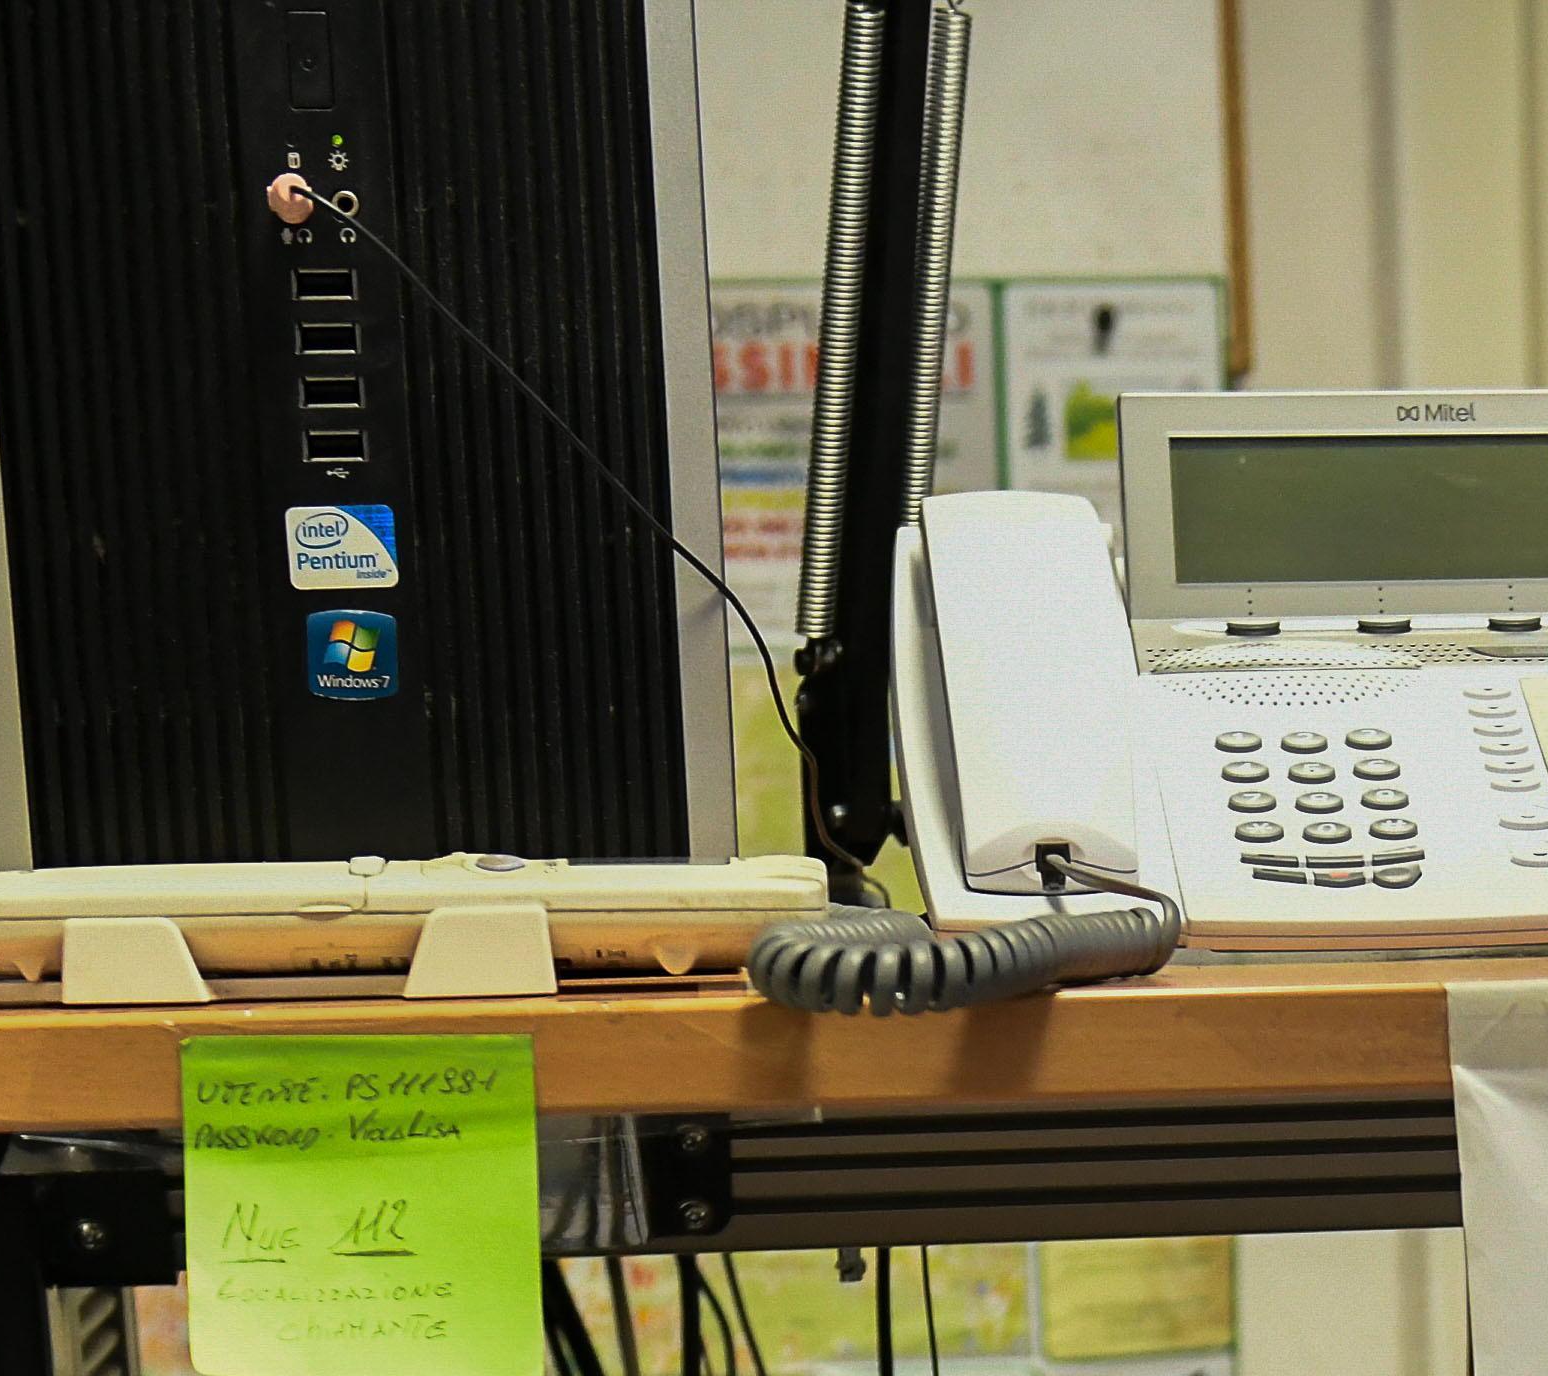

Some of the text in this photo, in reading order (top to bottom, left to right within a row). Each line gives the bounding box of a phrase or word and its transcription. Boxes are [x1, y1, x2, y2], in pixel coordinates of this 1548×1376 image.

[1425, 403, 1476, 422] Mitel
[302, 521, 341, 538] intel
[297, 551, 377, 570] Pentium
[317, 674, 381, 688] Windows
